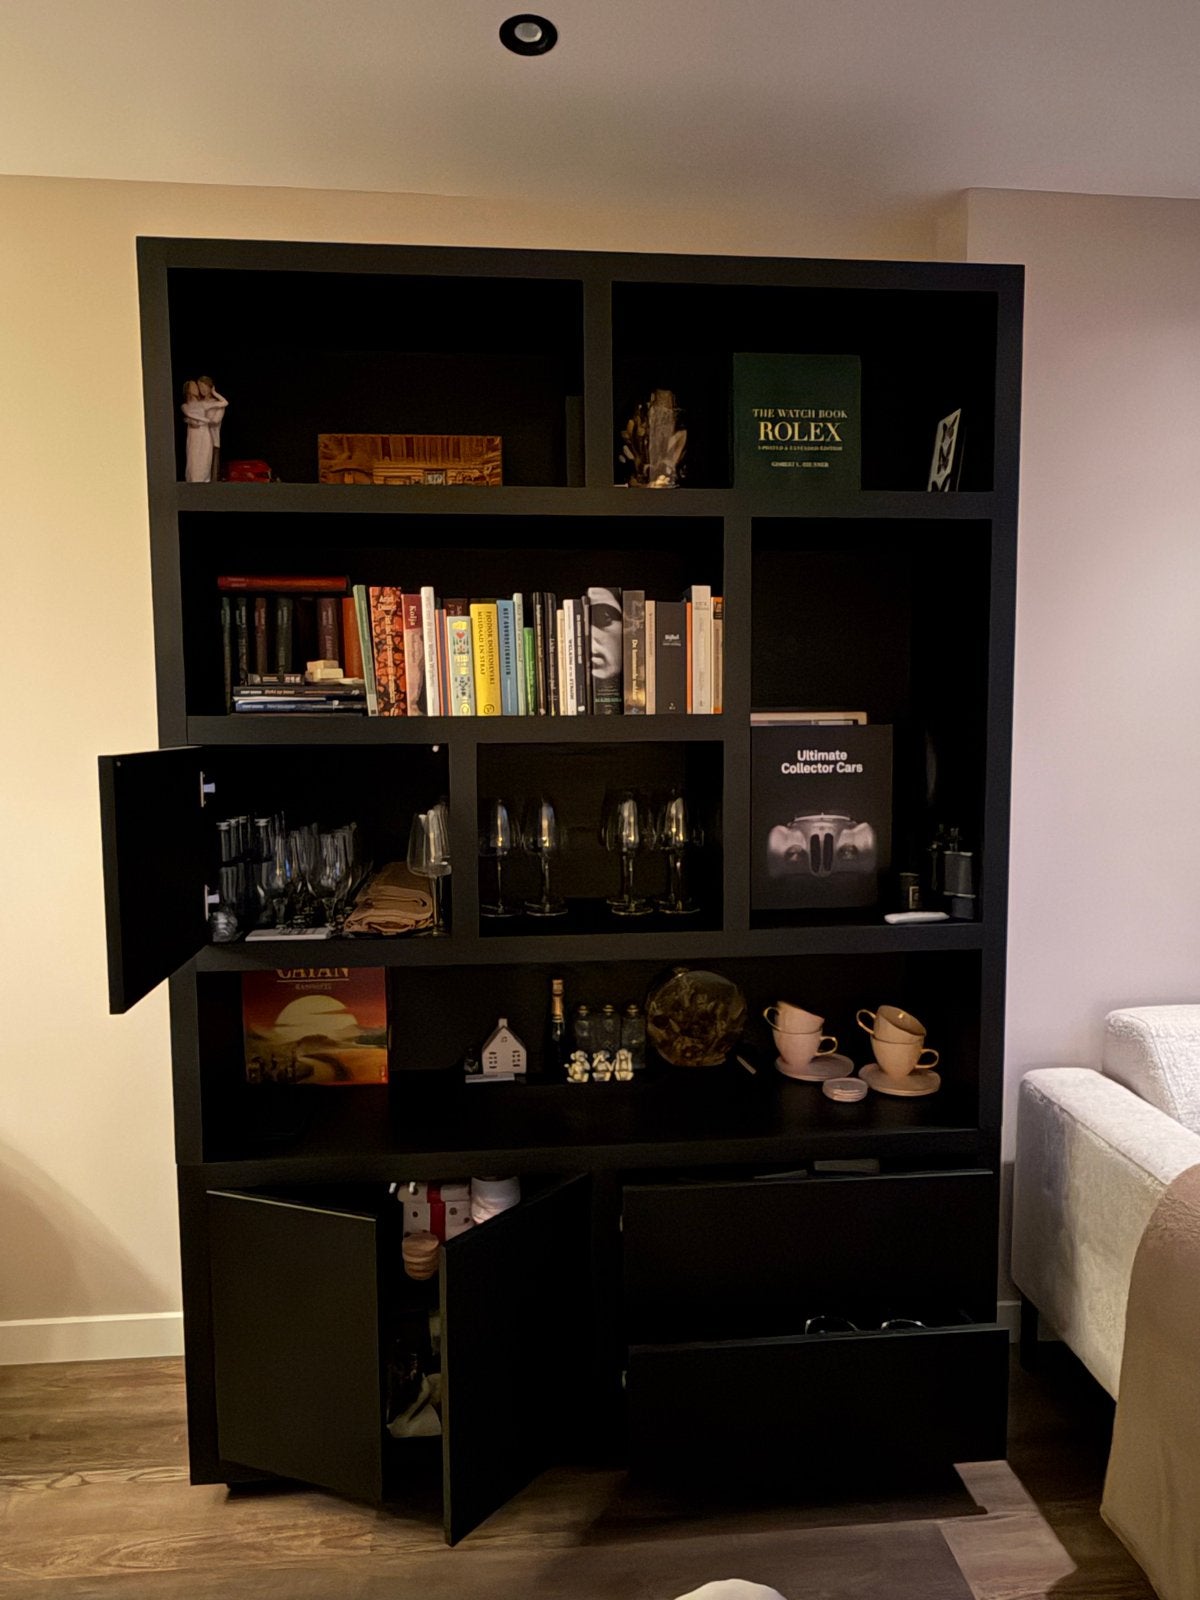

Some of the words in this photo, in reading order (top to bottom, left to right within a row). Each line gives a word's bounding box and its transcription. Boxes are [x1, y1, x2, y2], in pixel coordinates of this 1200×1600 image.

[752, 408, 775, 418] THE
[777, 408, 816, 419] WATCH
[818, 409, 848, 419] BOOK
[758, 421, 842, 442] ROLEX
[409, 605, 418, 626] Kolja
[479, 644, 485, 654] EN
[797, 749, 848, 761] Ultimate
[781, 762, 835, 774] Collector
[836, 762, 863, 774] Cars
